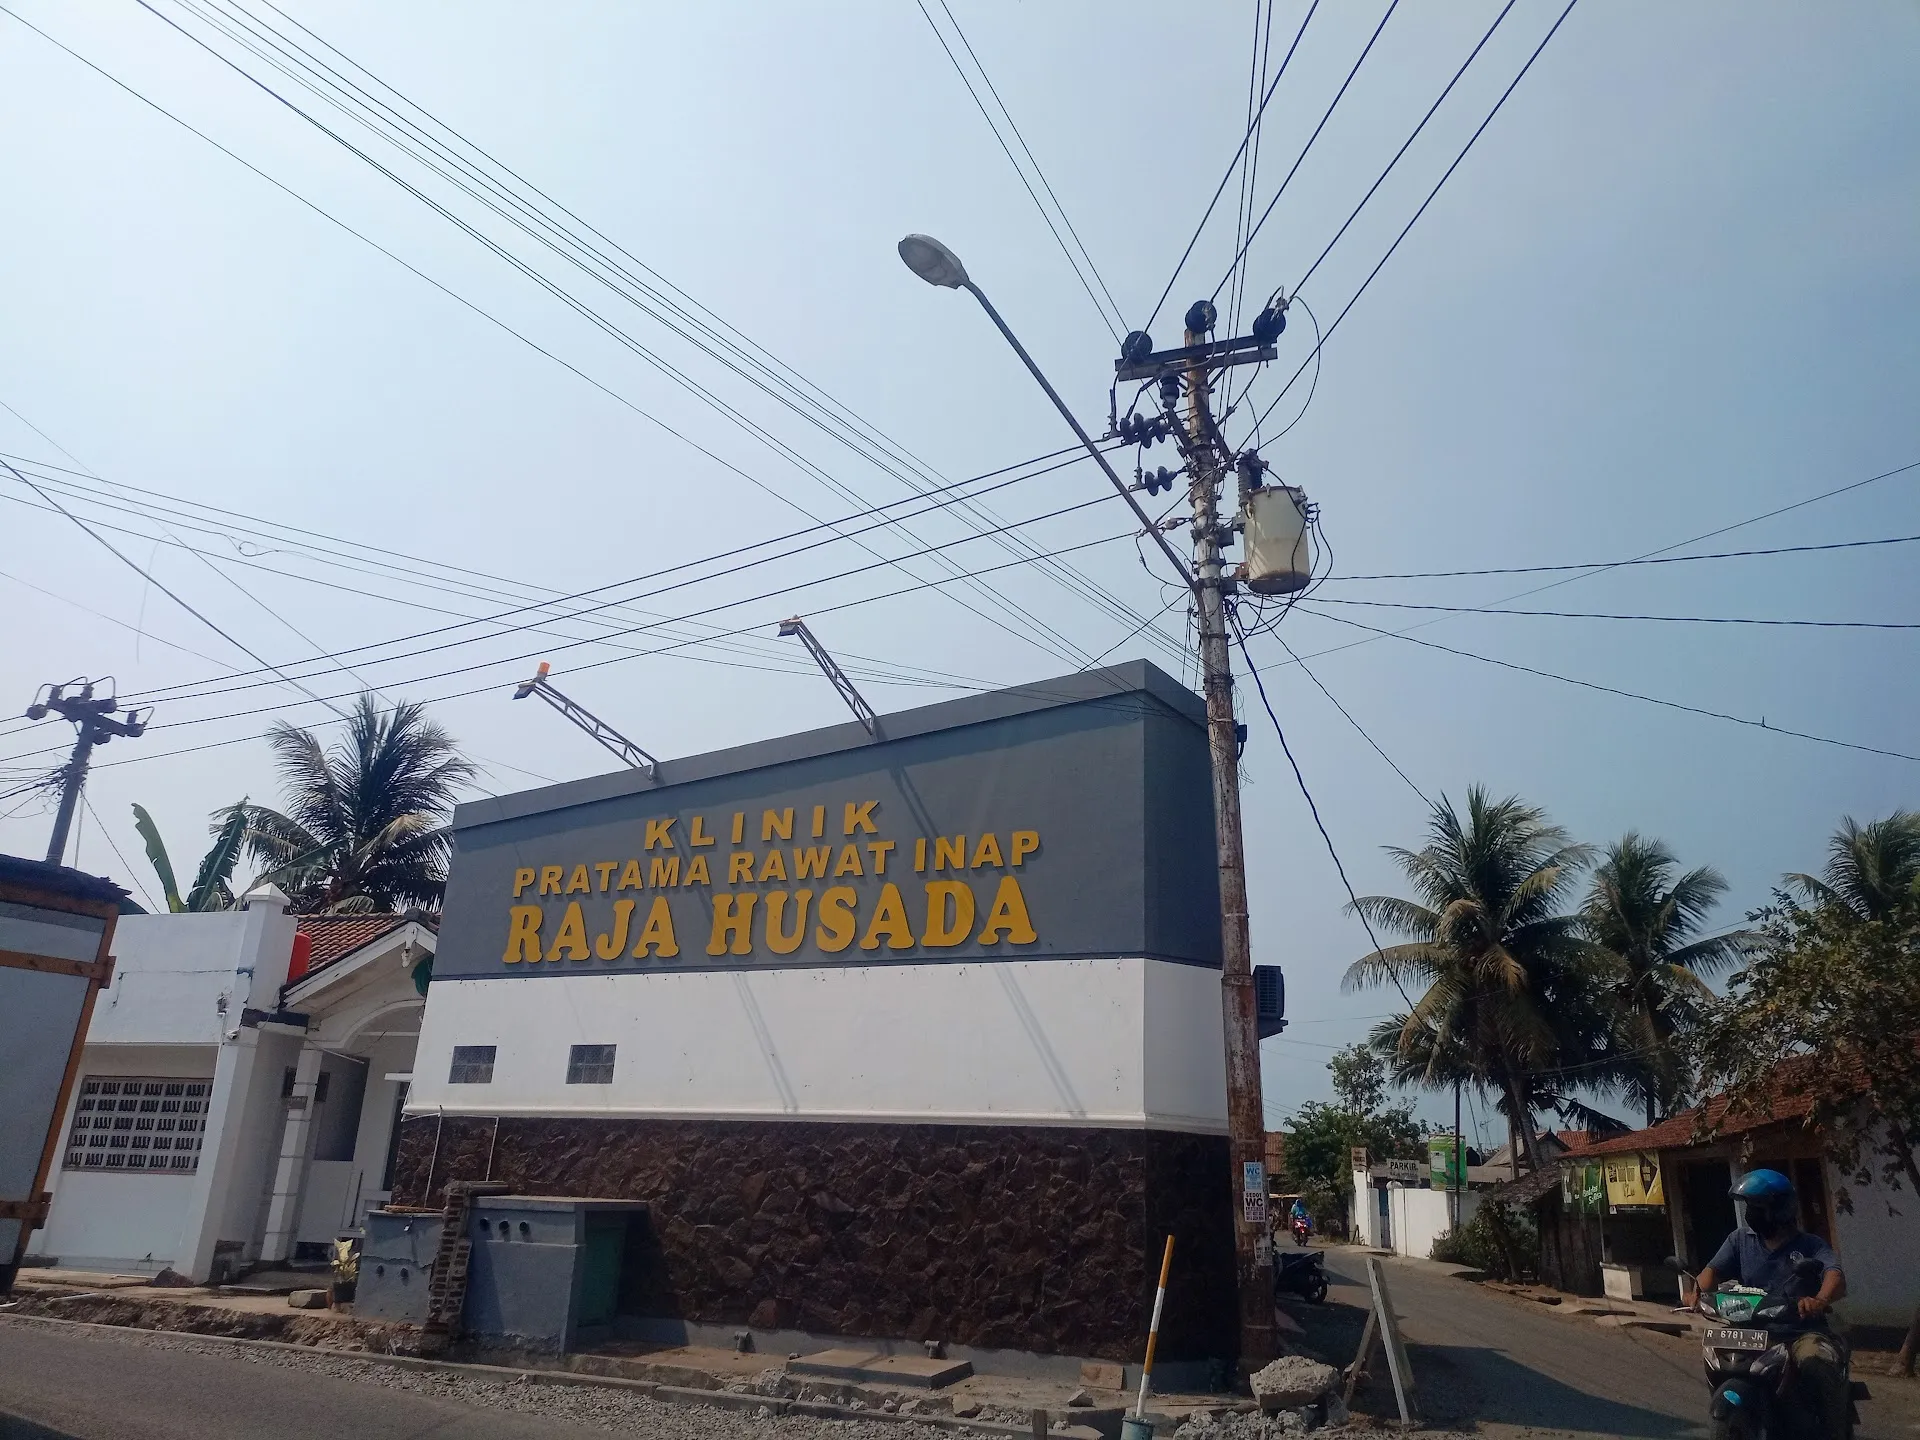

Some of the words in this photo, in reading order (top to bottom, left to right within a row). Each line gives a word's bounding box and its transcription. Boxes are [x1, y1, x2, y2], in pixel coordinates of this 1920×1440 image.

[643, 800, 880, 851] KLINIK
[512, 854, 711, 898] PRATAMA
[728, 840, 896, 884] RAWAT
[914, 830, 1040, 872] INAP
[502, 895, 679, 963] RAJA
[705, 875, 1038, 956] HUSADA
[1246, 1167, 1260, 1175] WC
[1245, 1198, 1263, 1207] WC
[1707, 1329, 1713, 1338] R
[1720, 1330, 1743, 1340] 6781
[1751, 1332, 1764, 1341] JK
